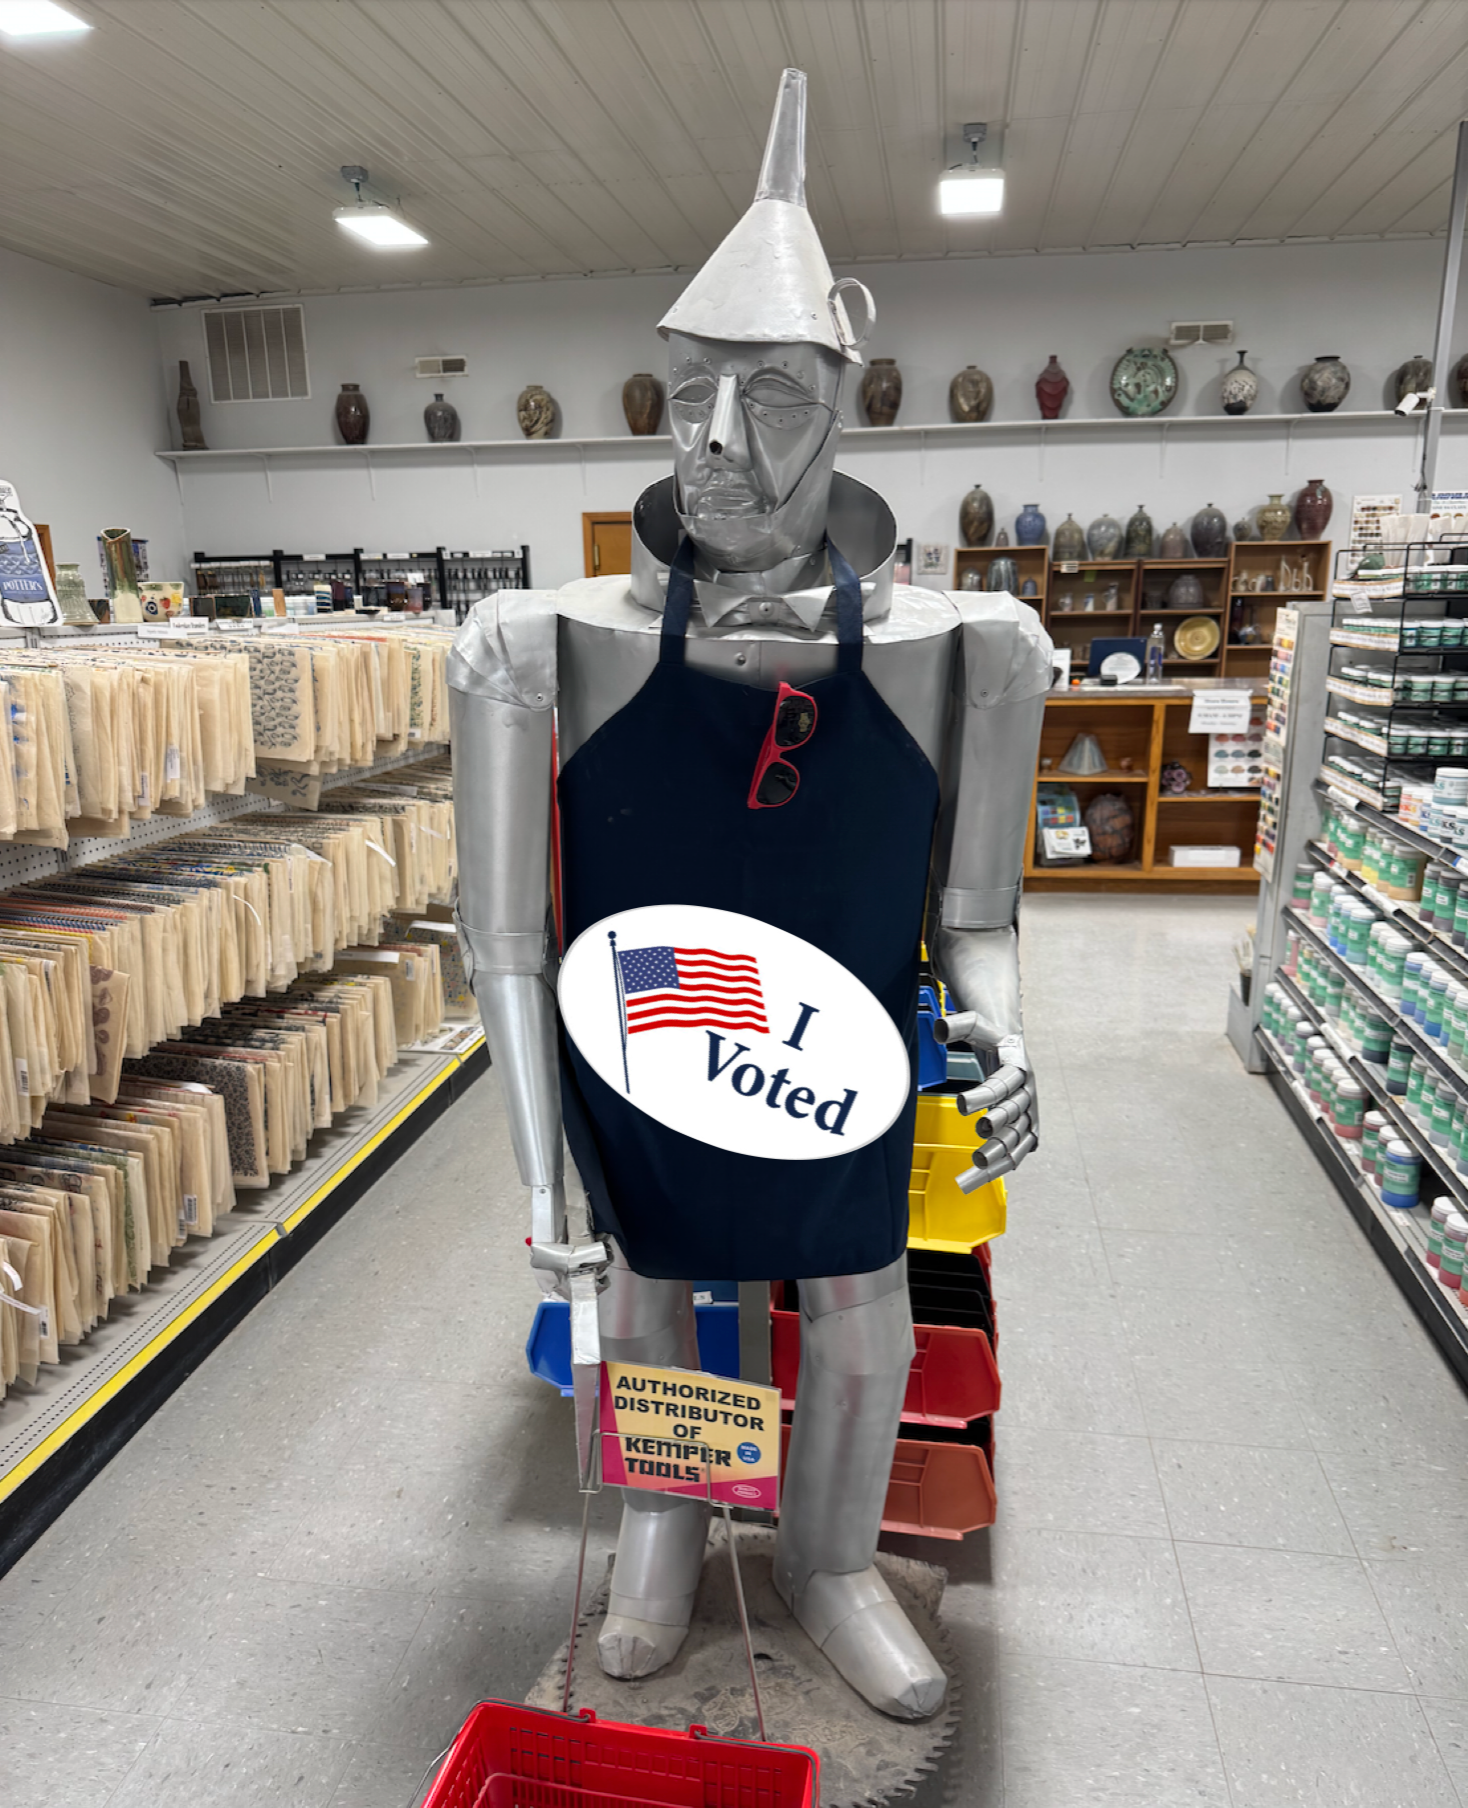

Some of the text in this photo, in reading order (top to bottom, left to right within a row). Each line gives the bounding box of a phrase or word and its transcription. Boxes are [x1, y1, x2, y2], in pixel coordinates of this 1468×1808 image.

[616, 1376, 761, 1410] AUTHORIZED
[614, 1396, 765, 1431] DISTRIBUTOR
[673, 1424, 702, 1439] OF
[625, 1437, 732, 1467] KEMPER
